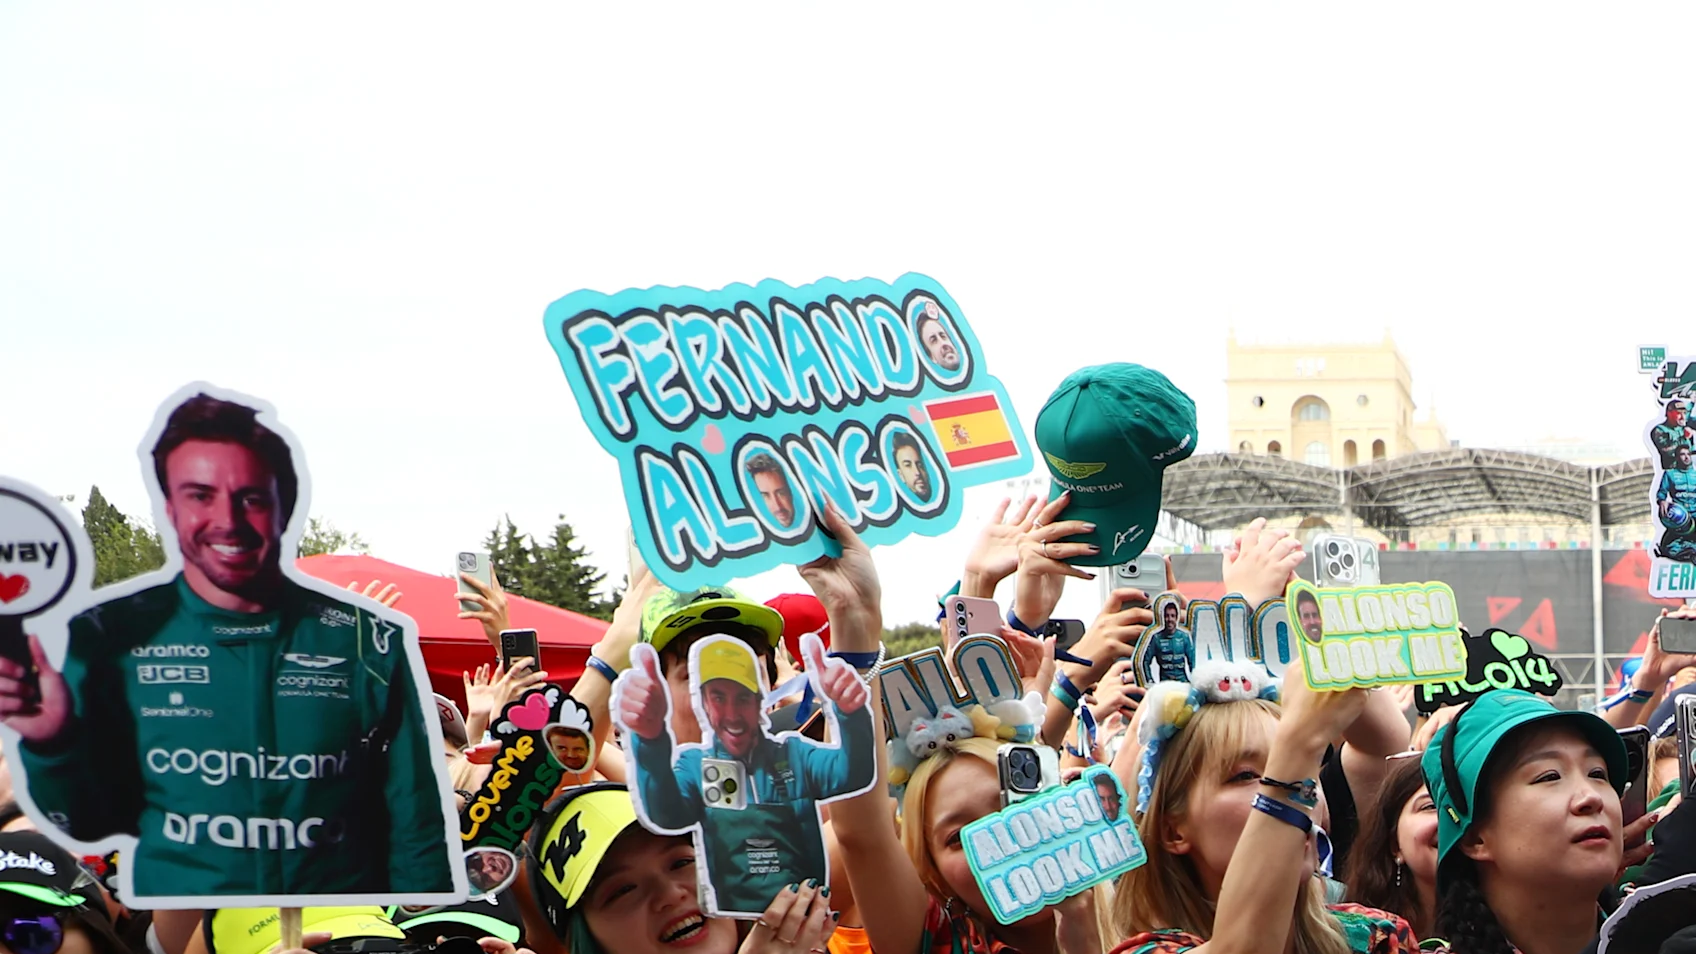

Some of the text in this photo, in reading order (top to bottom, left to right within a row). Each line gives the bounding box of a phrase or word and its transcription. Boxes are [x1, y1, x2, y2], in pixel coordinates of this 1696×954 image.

[564, 289, 974, 441] FERNANDO
[635, 414, 949, 575] ALONSO
[131, 644, 210, 658] aramco
[1322, 591, 1453, 634] ALONSO
[140, 667, 208, 682] JCB
[881, 636, 1022, 738] ALO
[1307, 633, 1465, 684] LOOK ME
[972, 788, 1103, 870] ALONSO
[988, 823, 1142, 915] LOOK ME
